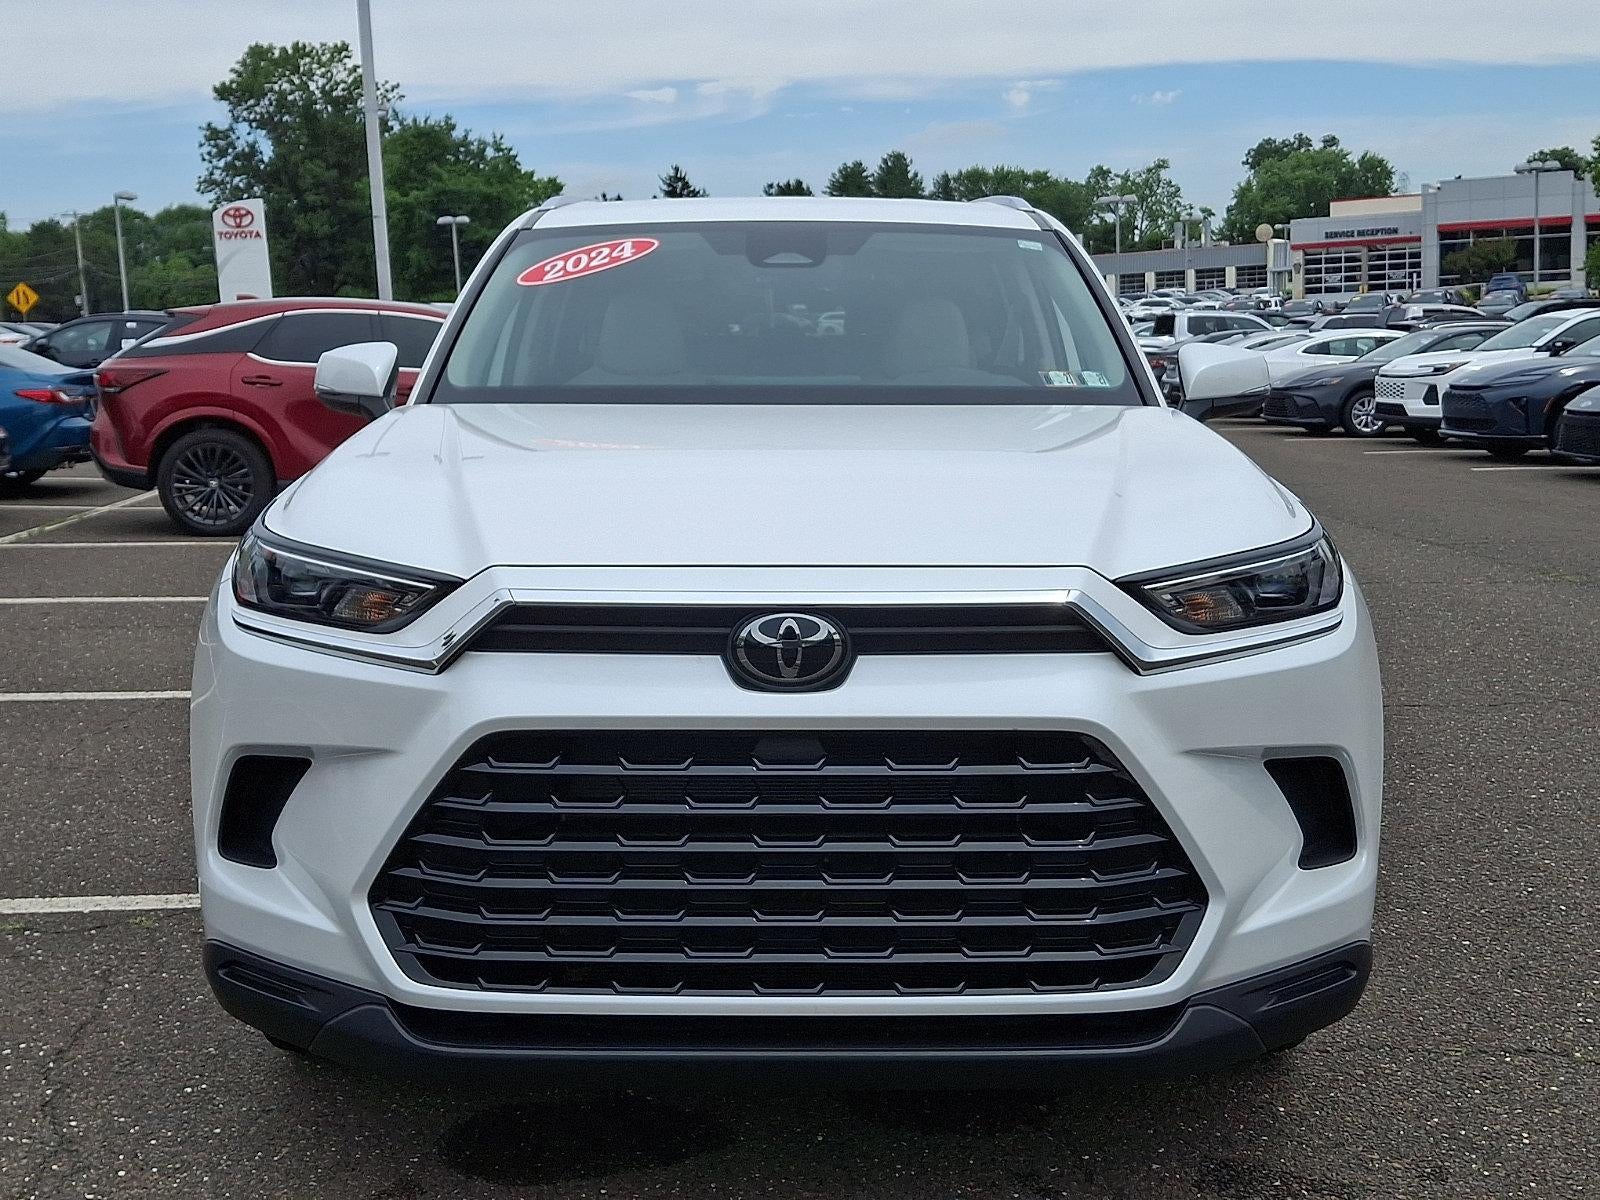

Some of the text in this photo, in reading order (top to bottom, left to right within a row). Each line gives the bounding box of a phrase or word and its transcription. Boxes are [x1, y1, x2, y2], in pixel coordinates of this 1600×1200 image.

[217, 230, 262, 240] TOYOTA
[1325, 227, 1399, 239] SERVICE RECEPTION
[542, 240, 636, 281] 2024
